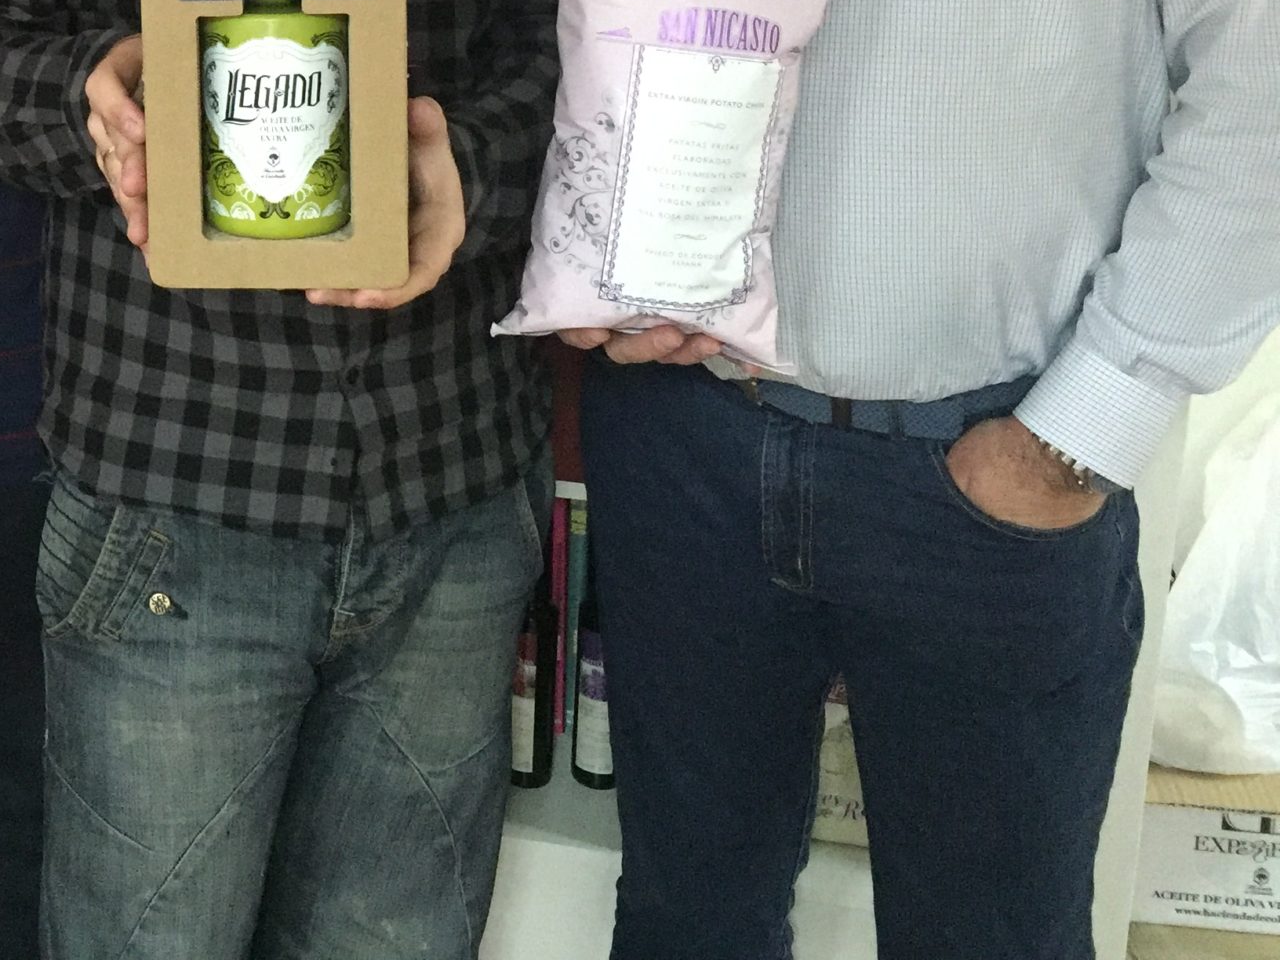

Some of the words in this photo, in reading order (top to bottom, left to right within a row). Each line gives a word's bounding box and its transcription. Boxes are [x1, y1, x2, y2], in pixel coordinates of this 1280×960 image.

[702, 7, 781, 54] NICASIO
[220, 68, 322, 125] LEGADO
[647, 91, 676, 101] EXTRA
[710, 99, 743, 109] POTATO
[1152, 890, 1200, 903] ACEITE
[1203, 894, 1222, 905] DE
[1225, 896, 1265, 909] OLIVA
